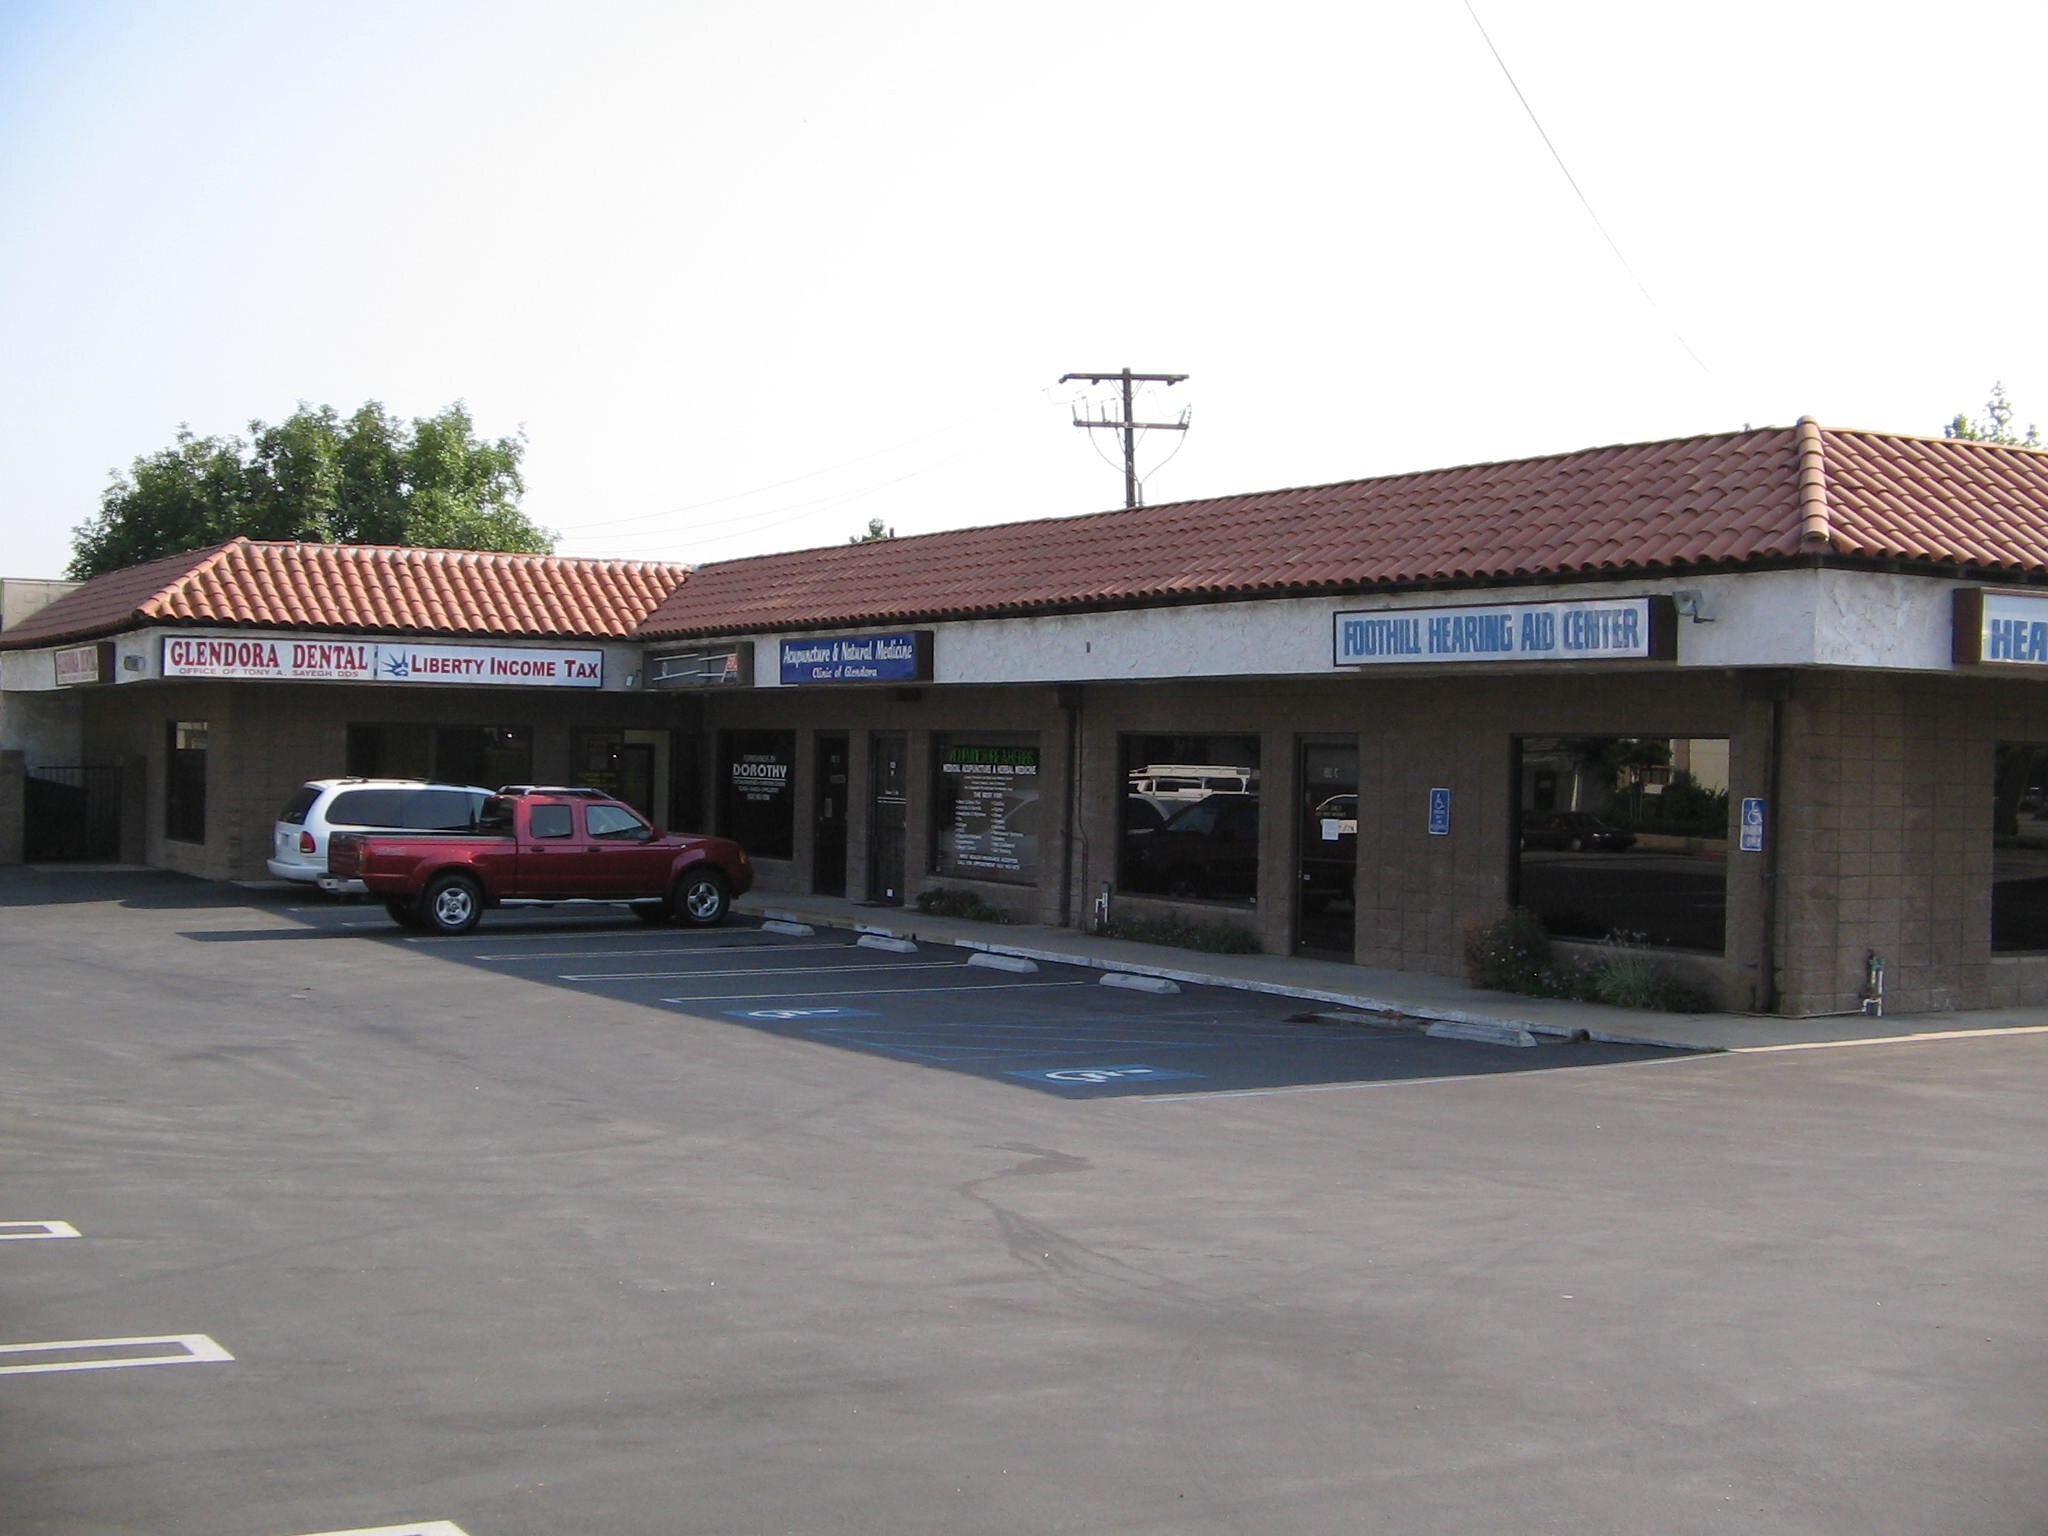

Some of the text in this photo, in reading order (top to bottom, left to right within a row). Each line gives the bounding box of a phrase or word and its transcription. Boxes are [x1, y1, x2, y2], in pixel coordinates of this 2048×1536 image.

[1343, 608, 1640, 656] FOOTHILL HEARING AID CENTER
[1991, 619, 2048, 662] HEA
[170, 640, 369, 670] GLENDORA DENTAL
[411, 654, 599, 678] LIBERTY INCOME TAX
[783, 645, 831, 669] Acupuncture
[841, 640, 873, 661] Natural
[875, 639, 913, 660] Medicine
[179, 667, 217, 675] OFFICE
[812, 665, 878, 679] Clinic of Glendora
[733, 763, 787, 778] DOROTHY
